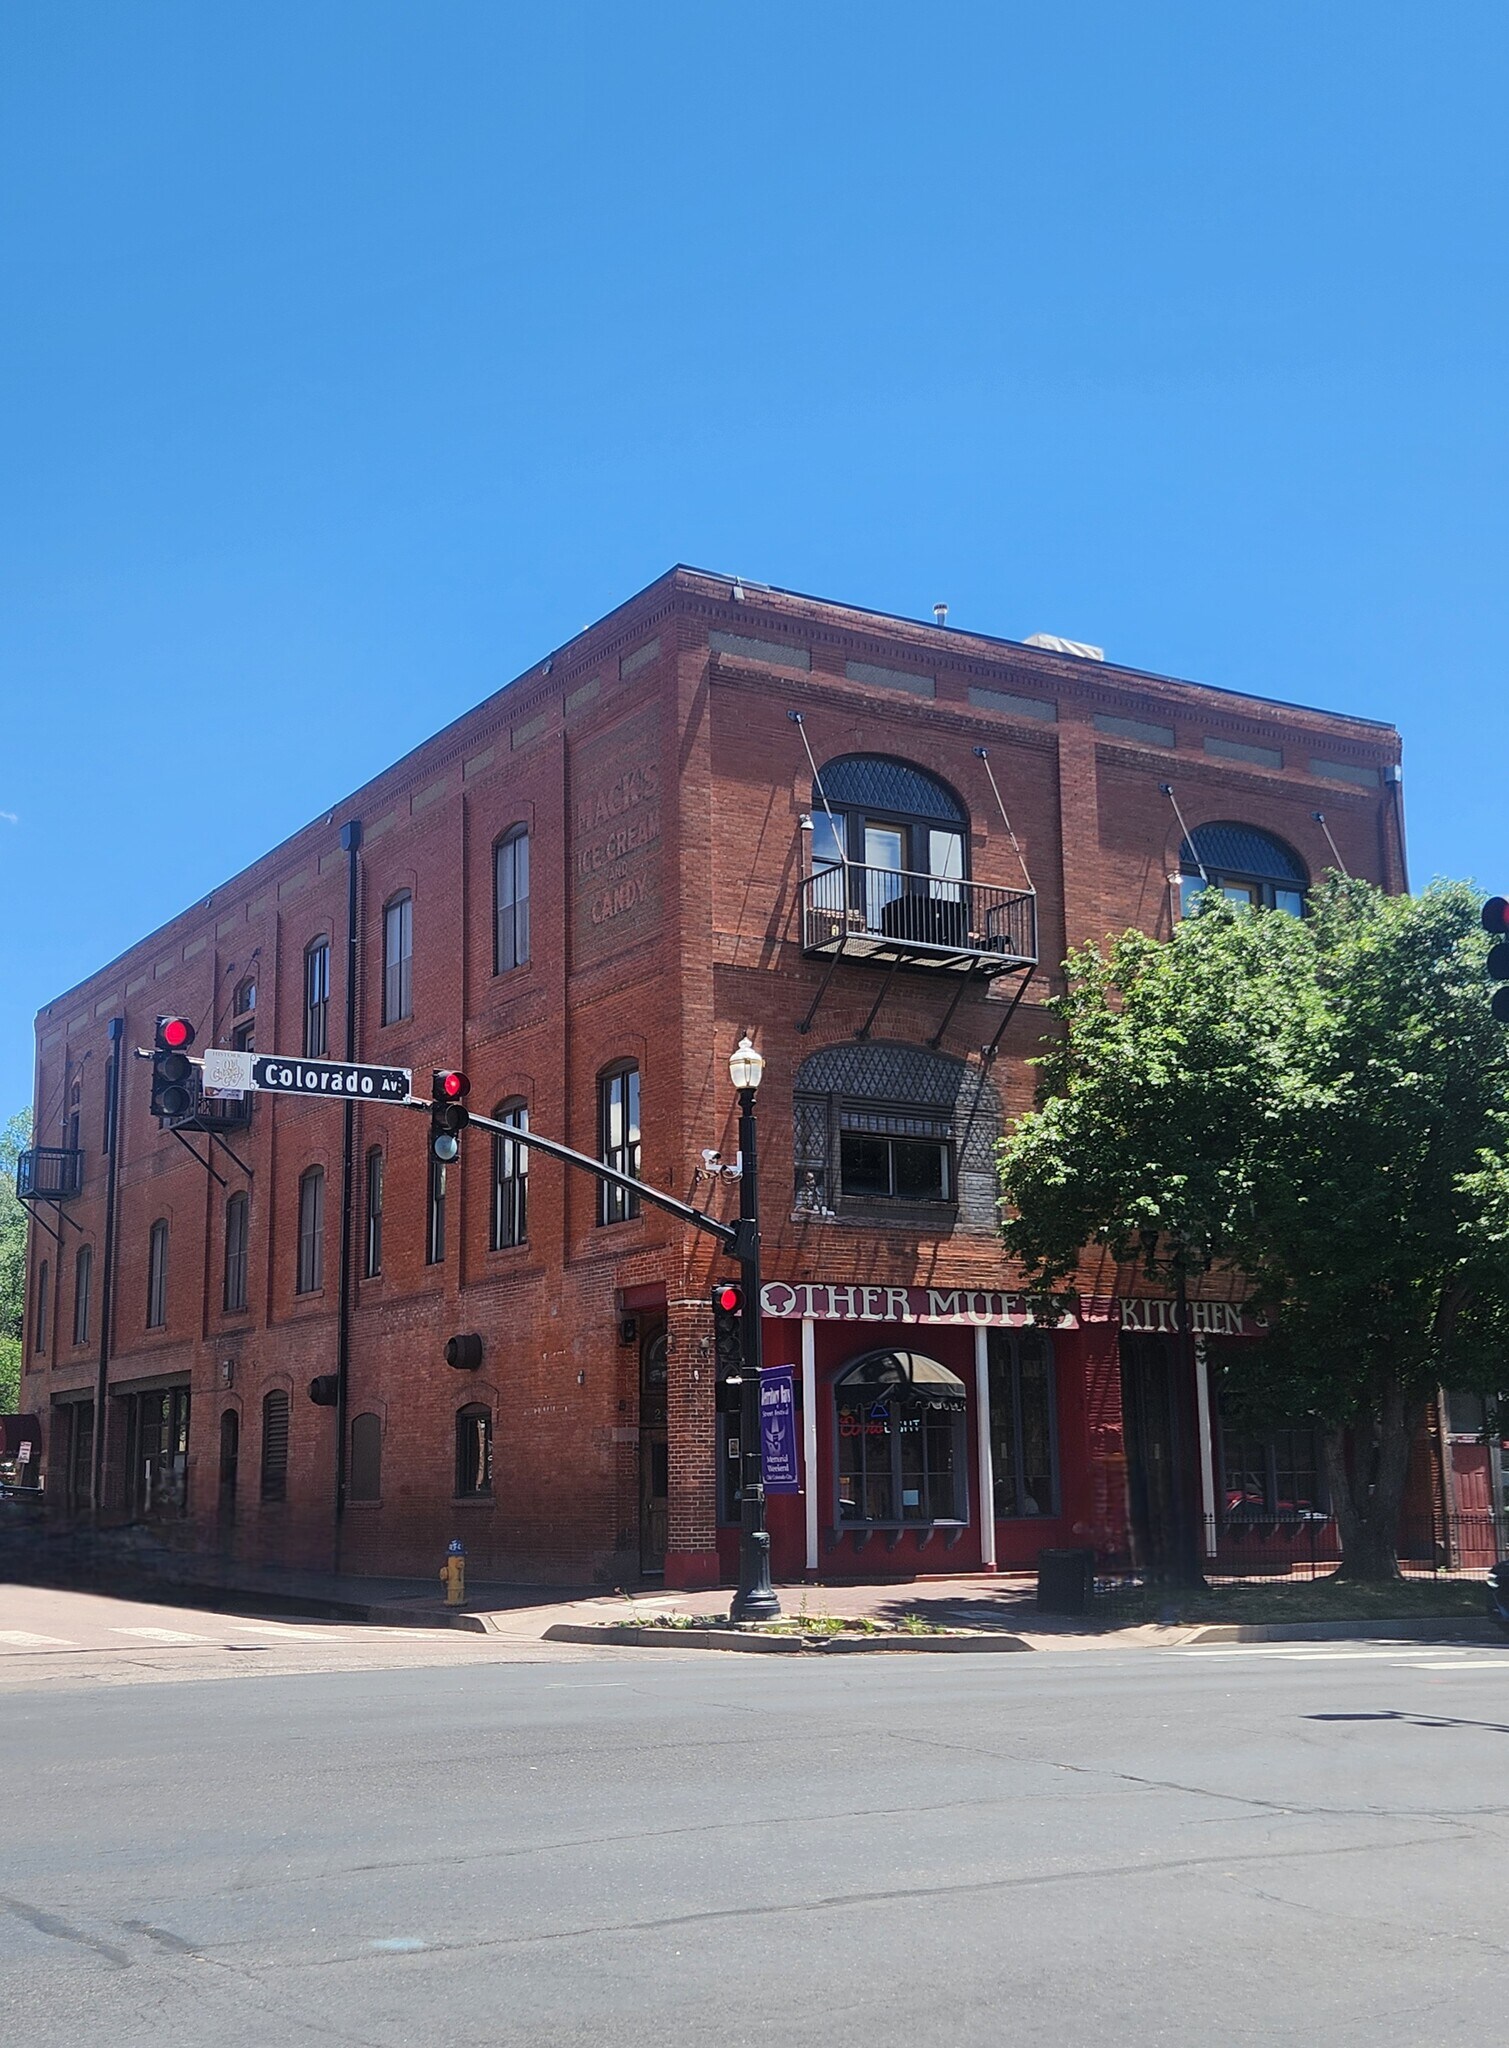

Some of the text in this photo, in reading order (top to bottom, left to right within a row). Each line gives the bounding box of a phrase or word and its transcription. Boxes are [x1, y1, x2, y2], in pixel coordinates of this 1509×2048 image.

[578, 810, 661, 876] ICE CREAM
[591, 870, 648, 924] CANDY
[265, 1064, 374, 1094] Colorado
